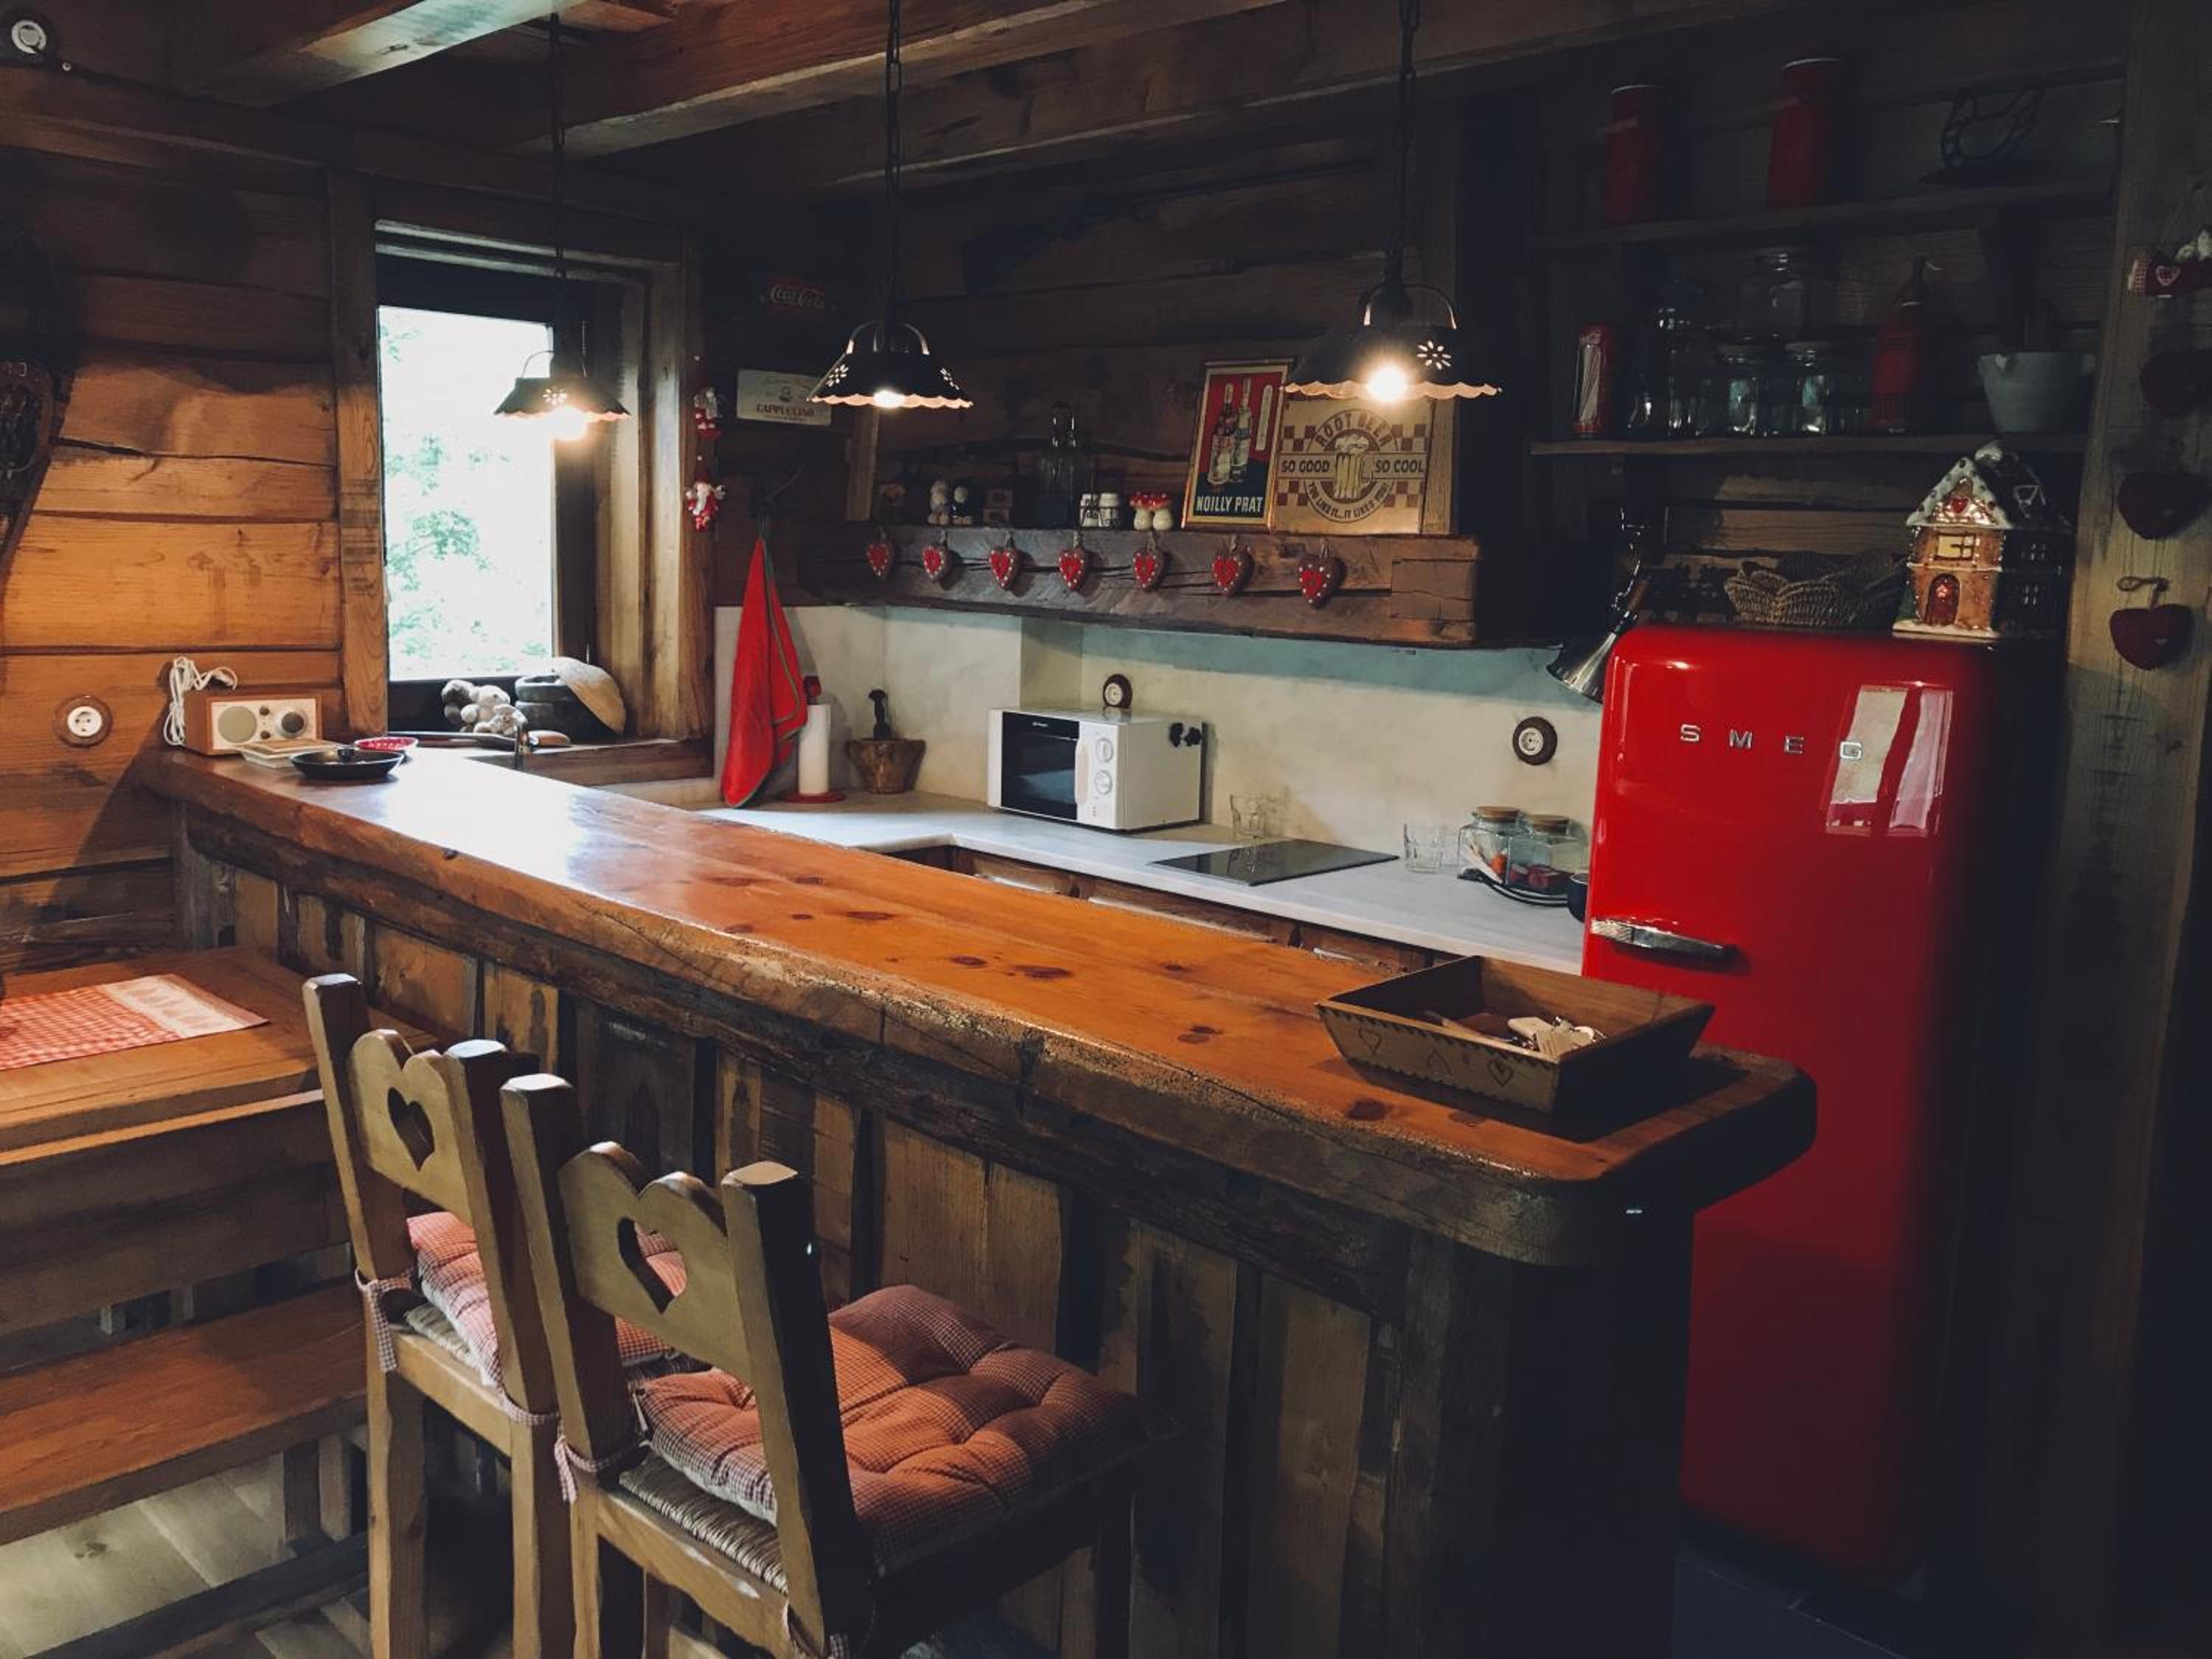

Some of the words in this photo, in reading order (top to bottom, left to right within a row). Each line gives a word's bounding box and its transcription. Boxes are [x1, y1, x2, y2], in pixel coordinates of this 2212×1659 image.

[1315, 413, 1352, 448] ROOT
[1357, 413, 1392, 447] BEER
[1281, 459, 1295, 473] SO
[1298, 459, 1330, 473] GOOD
[1375, 459, 1390, 473] SO
[1393, 459, 1424, 473] COOL
[1196, 495, 1232, 512] NOILLY
[1234, 495, 1263, 513] PRAT
[1680, 723, 1863, 760] SMEG
